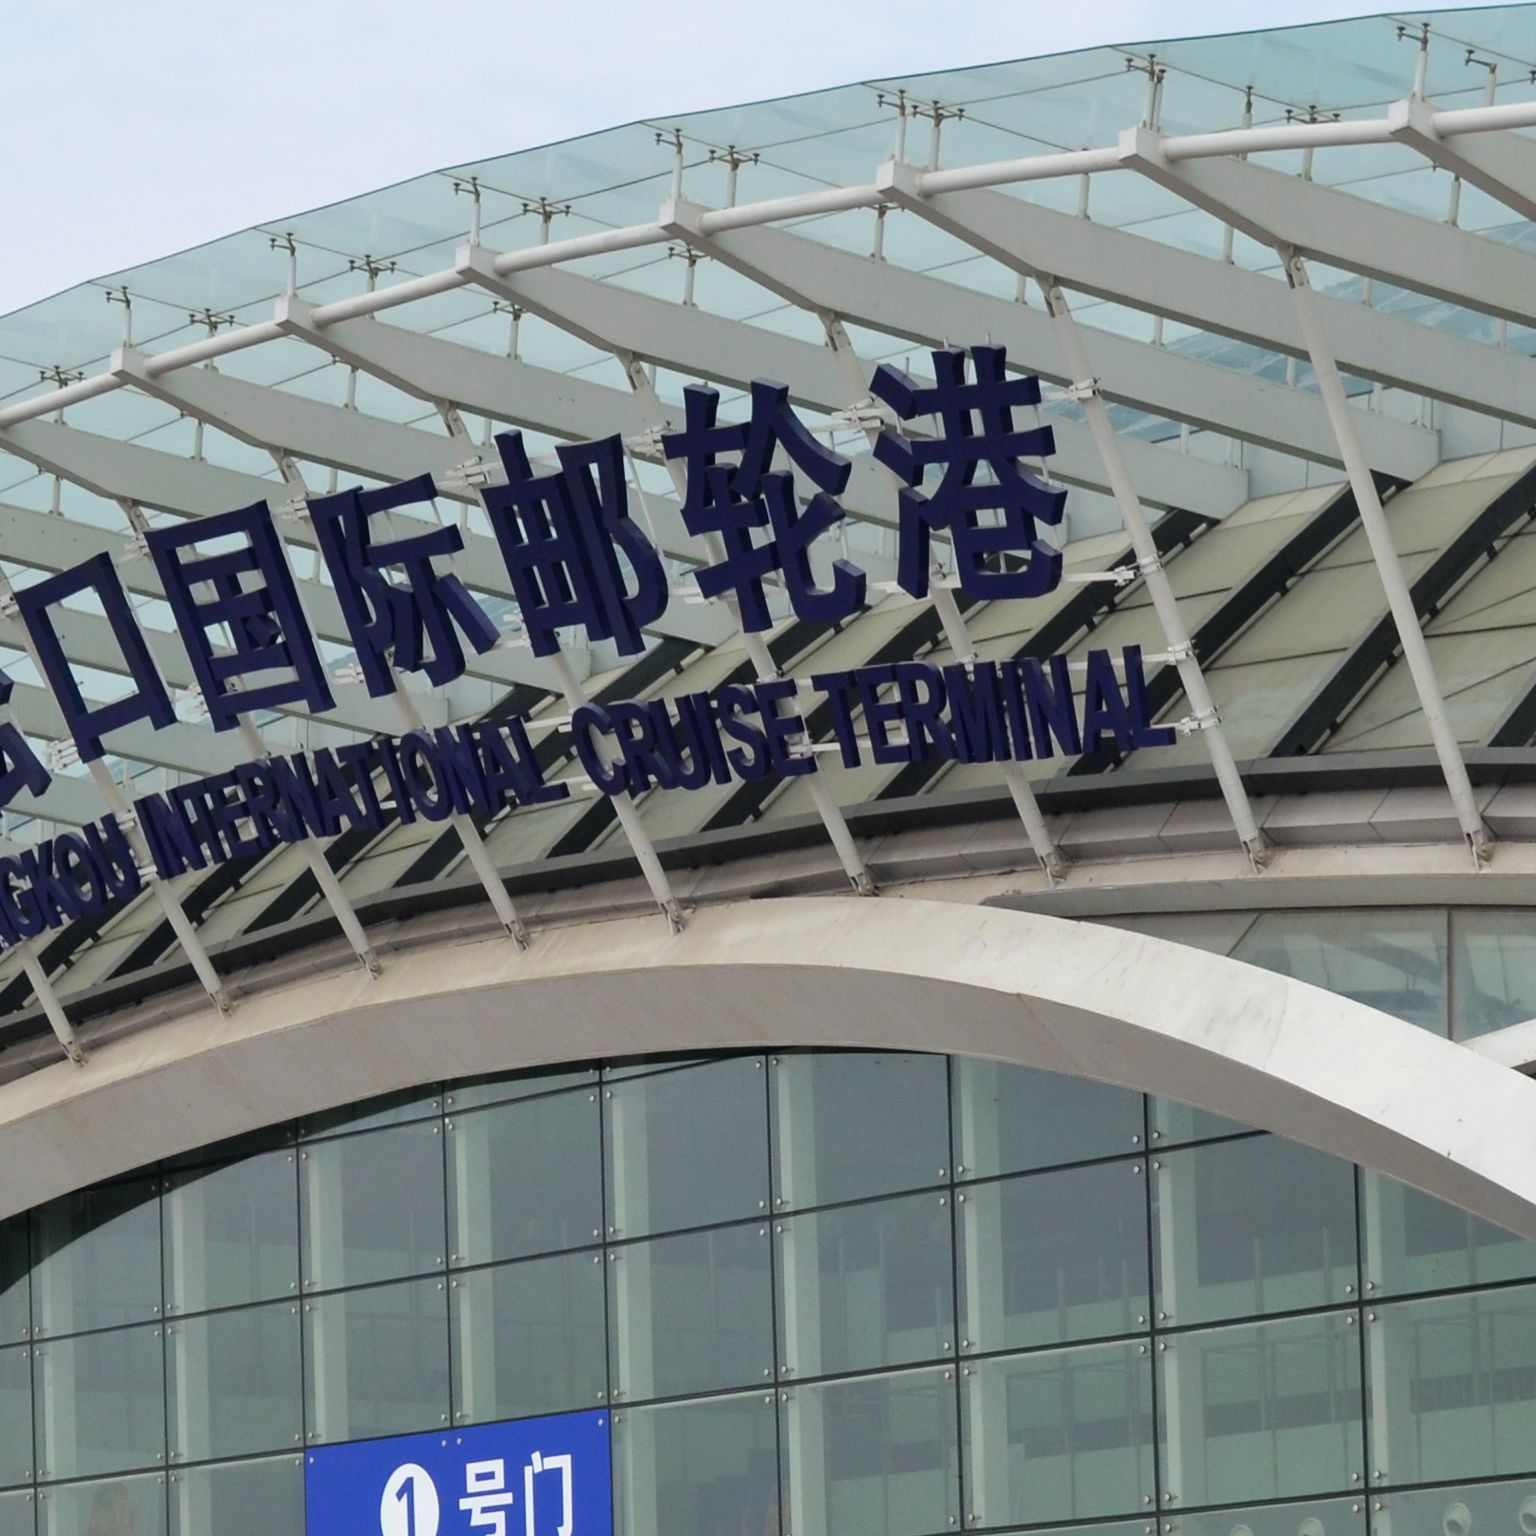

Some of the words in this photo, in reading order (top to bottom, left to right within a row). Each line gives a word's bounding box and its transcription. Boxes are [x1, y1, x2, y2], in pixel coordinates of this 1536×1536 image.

[134, 713, 569, 881] INTERNATIONAL
[569, 678, 818, 796] CRUISE
[810, 644, 1178, 768] TERMINAL
